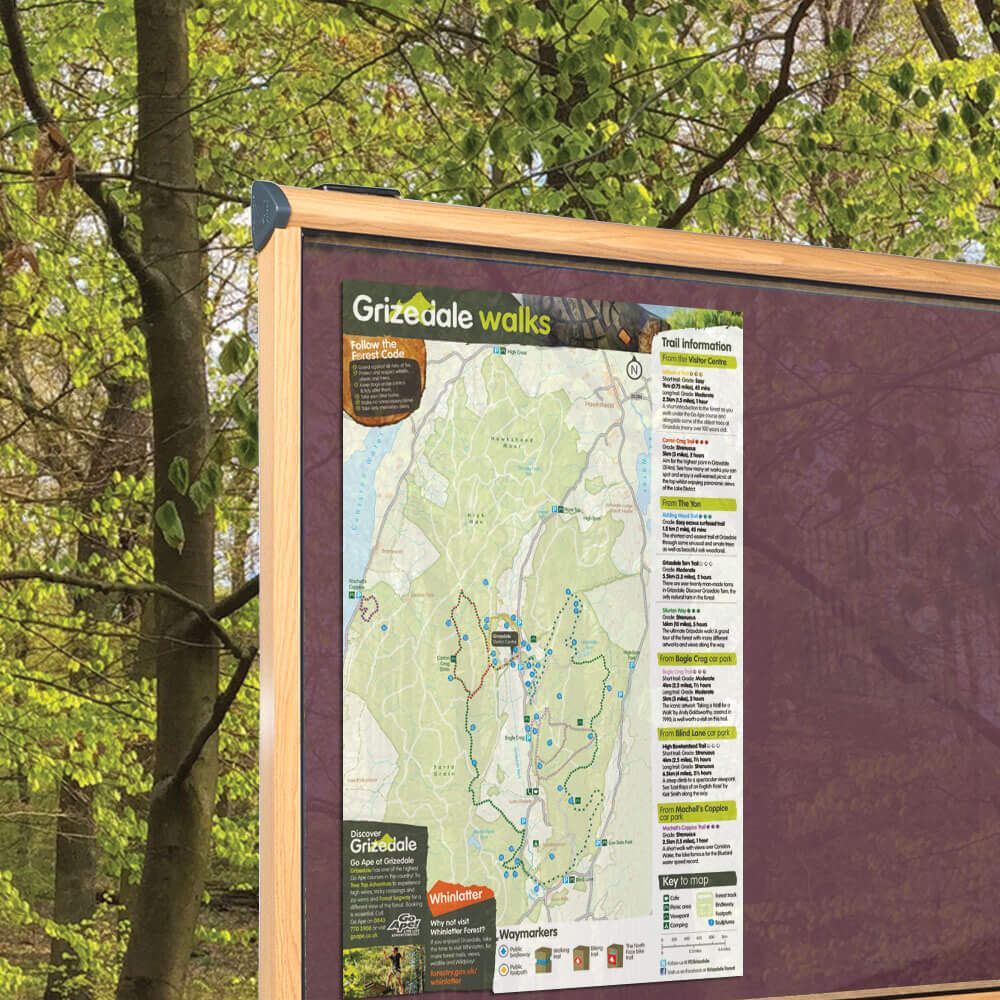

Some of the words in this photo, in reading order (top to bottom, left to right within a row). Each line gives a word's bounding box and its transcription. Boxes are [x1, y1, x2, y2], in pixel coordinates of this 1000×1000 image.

[352, 294, 474, 329] Grizedale
[478, 305, 551, 335] walks
[351, 339, 380, 350] Follow
[382, 338, 397, 349] the
[662, 336, 680, 349] Trail
[682, 338, 732, 352] information
[352, 350, 379, 360] Forest
[381, 349, 405, 359] Code
[689, 355, 706, 364] Visitor
[708, 356, 727, 365] Centre
[630, 364, 638, 376] N
[675, 655, 692, 664] Bogle
[693, 655, 708, 664] Crag
[719, 655, 732, 664] park
[692, 729, 706, 737] Lane
[717, 729, 729, 738] park
[675, 805, 703, 813] Machell's
[705, 804, 729, 813] Coppice
[671, 814, 683, 822] park
[350, 829, 382, 838] Discover
[350, 836, 417, 853] Grizedale
[350, 858, 360, 867] Go
[361, 858, 374, 867] Ape
[375, 857, 382, 865] at
[384, 856, 414, 865] Grizedale
[663, 876, 679, 888] Key
[680, 876, 688, 885] to
[690, 876, 709, 887] map
[430, 890, 483, 905] Whinlatter
[399, 913, 416, 922] Go
[387, 919, 422, 933] Ape!
[430, 919, 445, 929] Why
[457, 918, 470, 926] visit
[430, 927, 463, 936] Whinlatter
[464, 926, 486, 934] Forest?
[499, 926, 558, 942] Waymarkers
